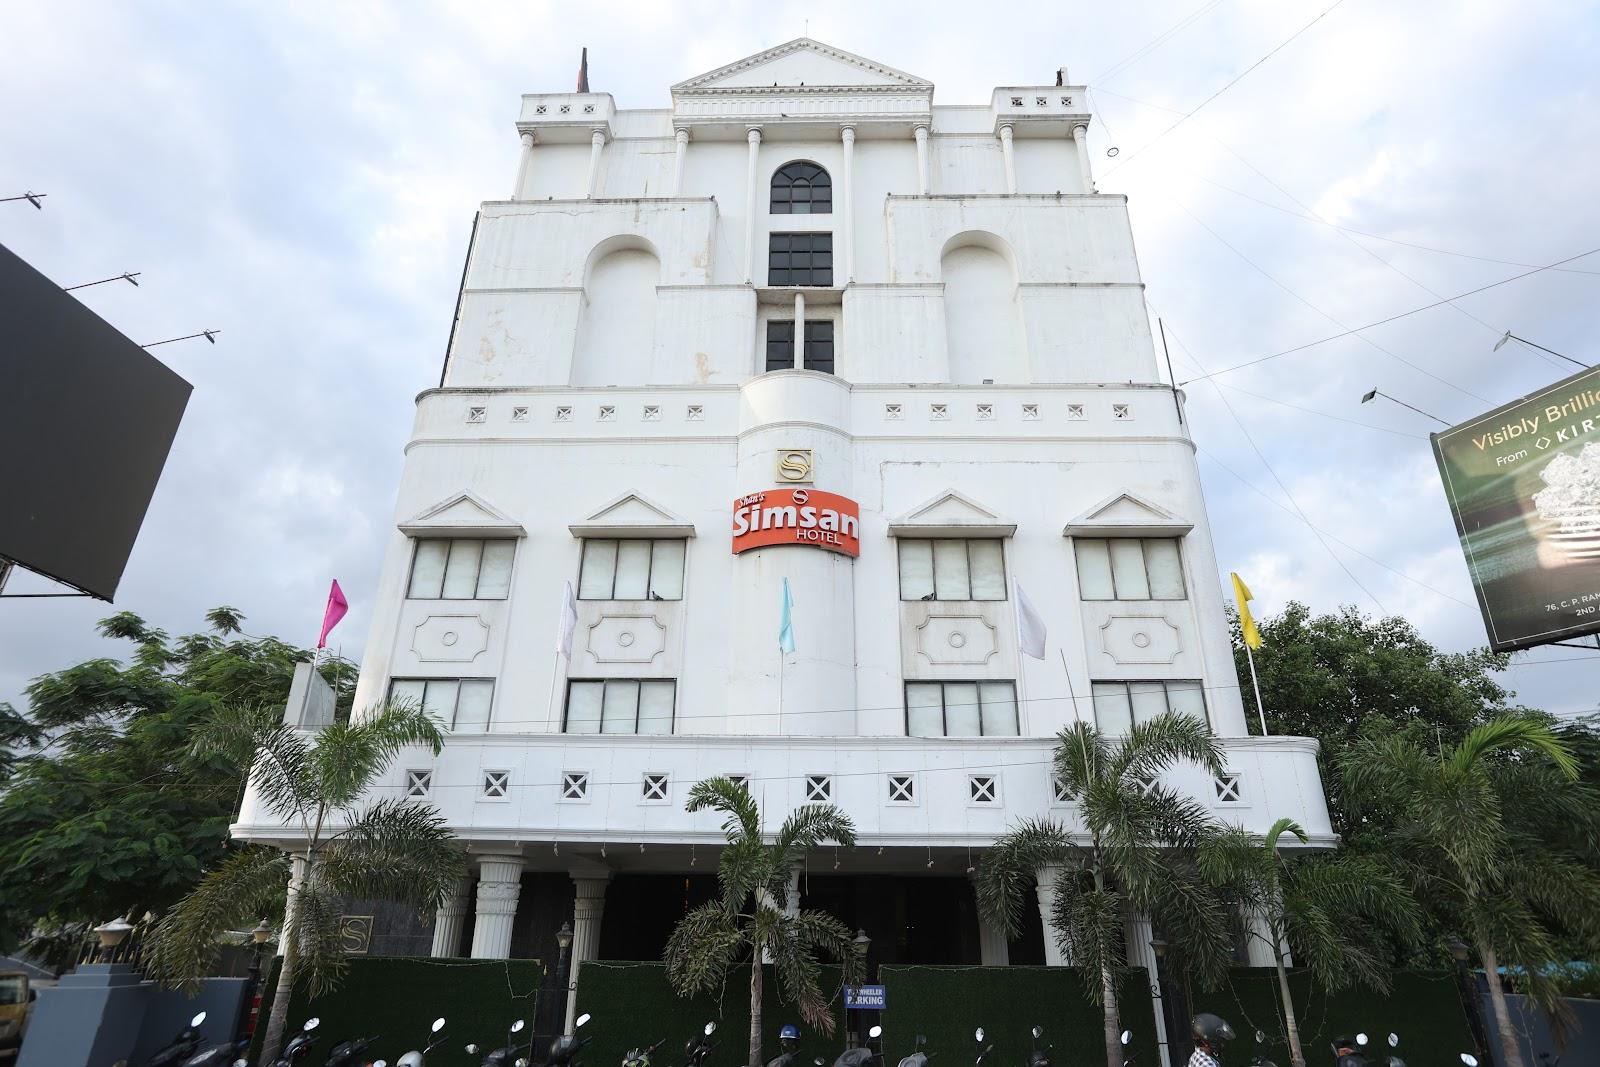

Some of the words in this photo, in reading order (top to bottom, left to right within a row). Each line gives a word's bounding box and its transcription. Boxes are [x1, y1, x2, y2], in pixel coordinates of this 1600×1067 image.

[1472, 416, 1539, 450] Visibly
[1496, 449, 1528, 466] From
[733, 504, 859, 539] Simsan
[796, 529, 843, 545] HOTEL
[1560, 600, 1571, 608] C.
[1575, 606, 1596, 616] 2ND
[847, 996, 883, 1005] PRKING
